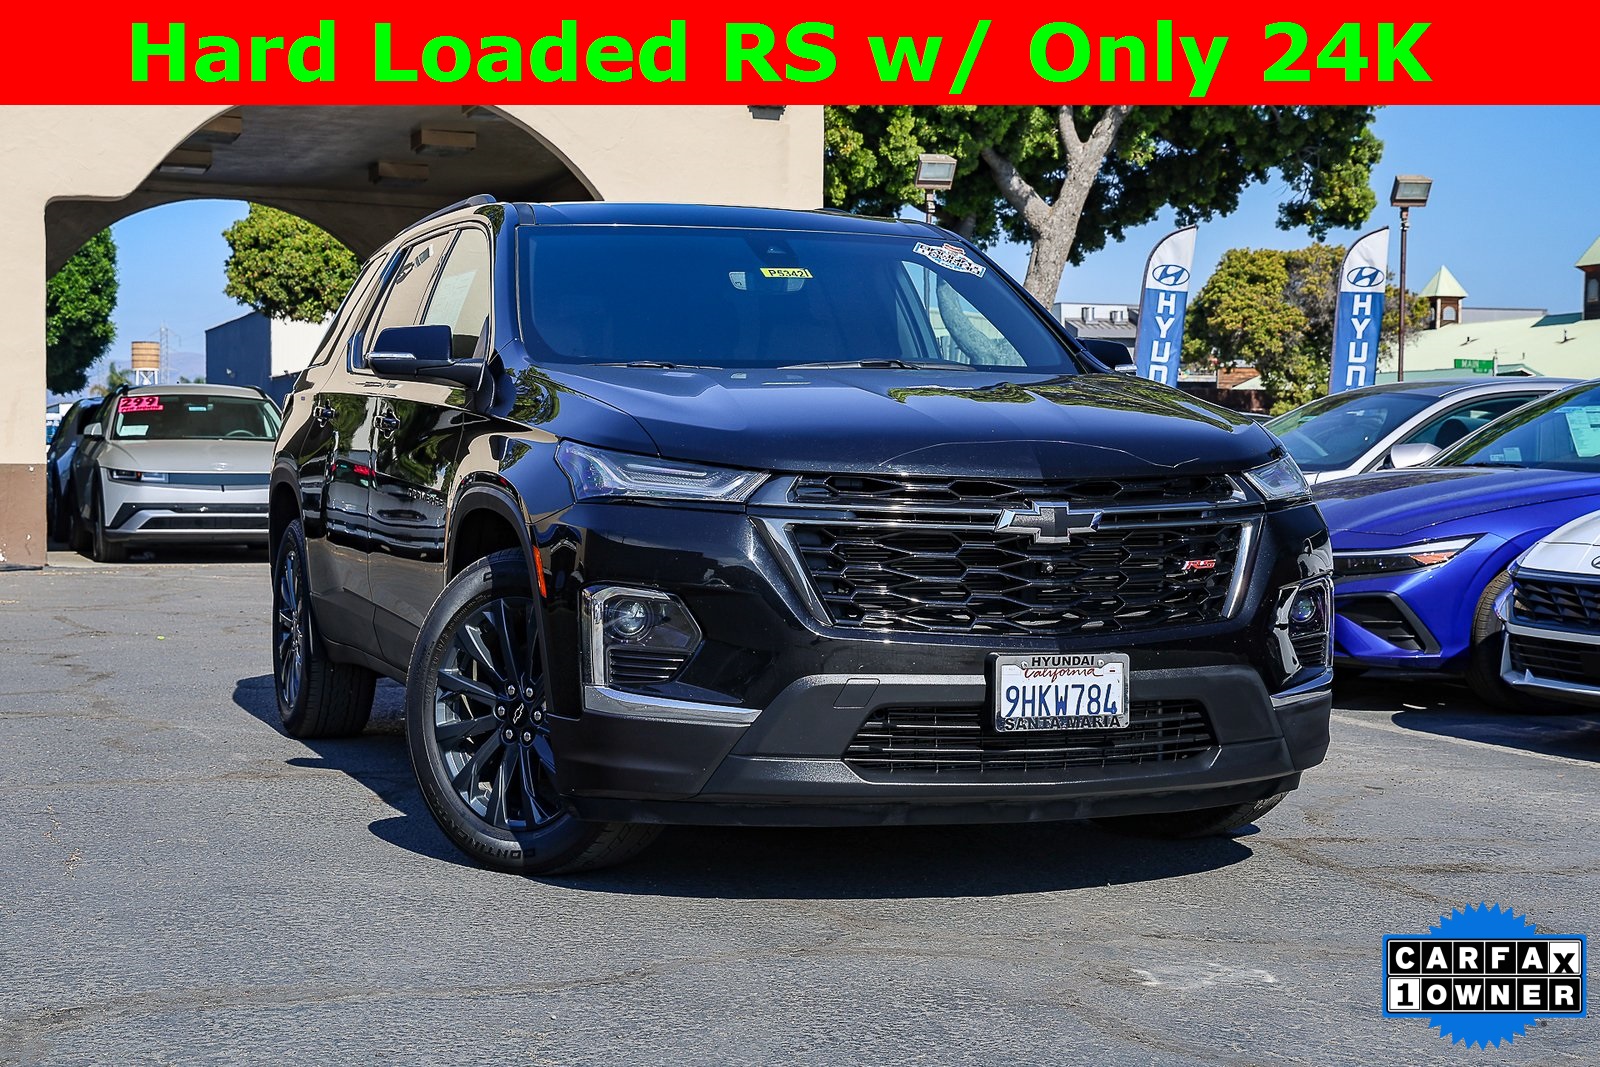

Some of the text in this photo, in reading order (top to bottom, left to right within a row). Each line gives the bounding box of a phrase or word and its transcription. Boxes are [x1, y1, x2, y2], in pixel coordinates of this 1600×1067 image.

[1181, 559, 1216, 570] RS
[1031, 655, 1095, 667] HYUNDAI
[1024, 667, 1104, 683] California
[1005, 684, 1118, 717] 9HKW784
[1004, 715, 1121, 731] SANTA MARIA
